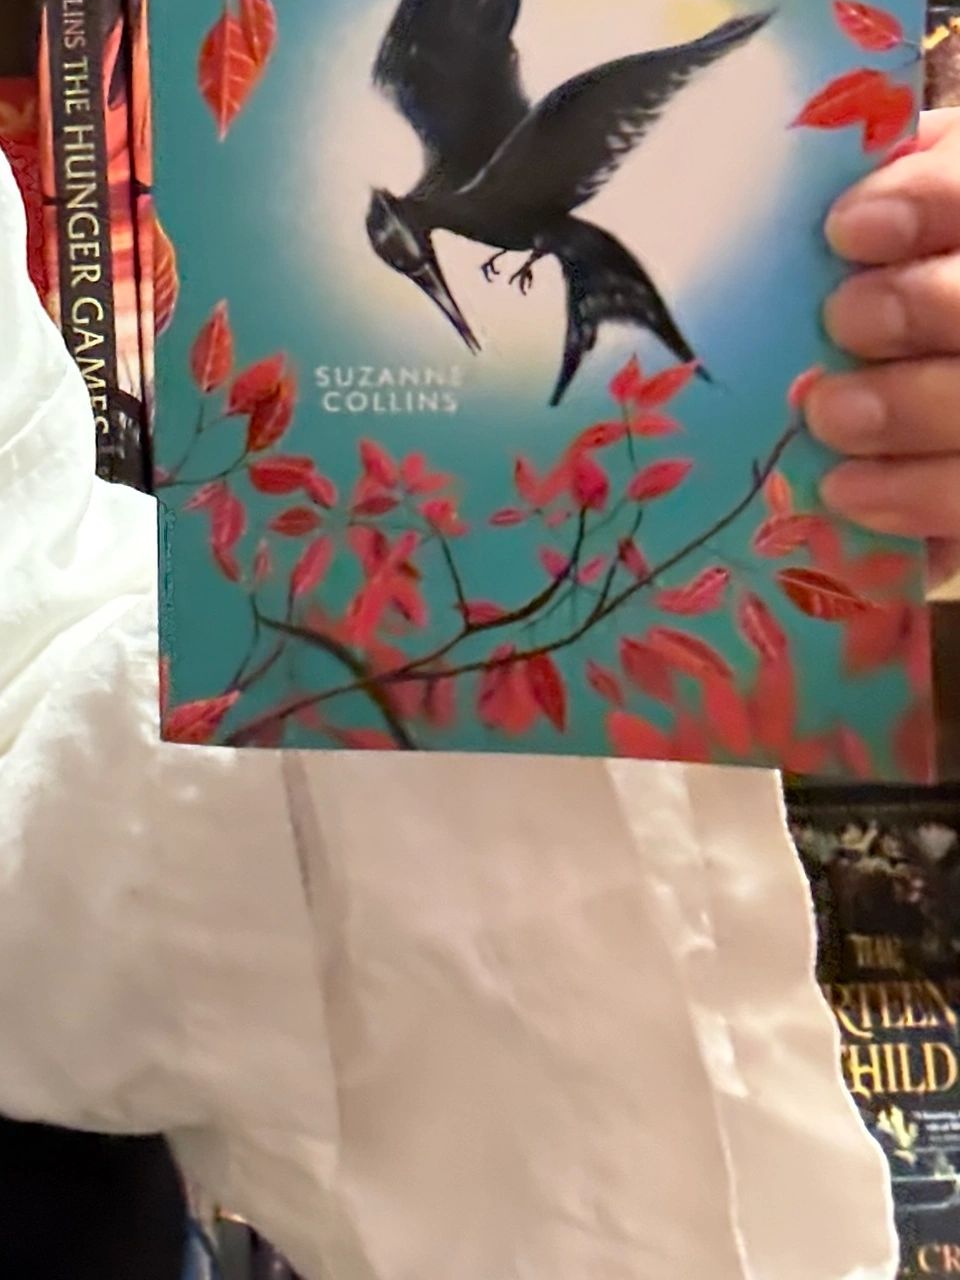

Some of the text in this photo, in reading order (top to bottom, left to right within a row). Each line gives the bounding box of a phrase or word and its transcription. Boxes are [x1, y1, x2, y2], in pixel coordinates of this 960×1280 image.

[63, 56, 90, 114] THE
[63, 125, 102, 288] HUNGER
[315, 366, 463, 387] SUZANNE
[322, 391, 458, 412] COLLINS
[841, 1042, 959, 1098] HILD
